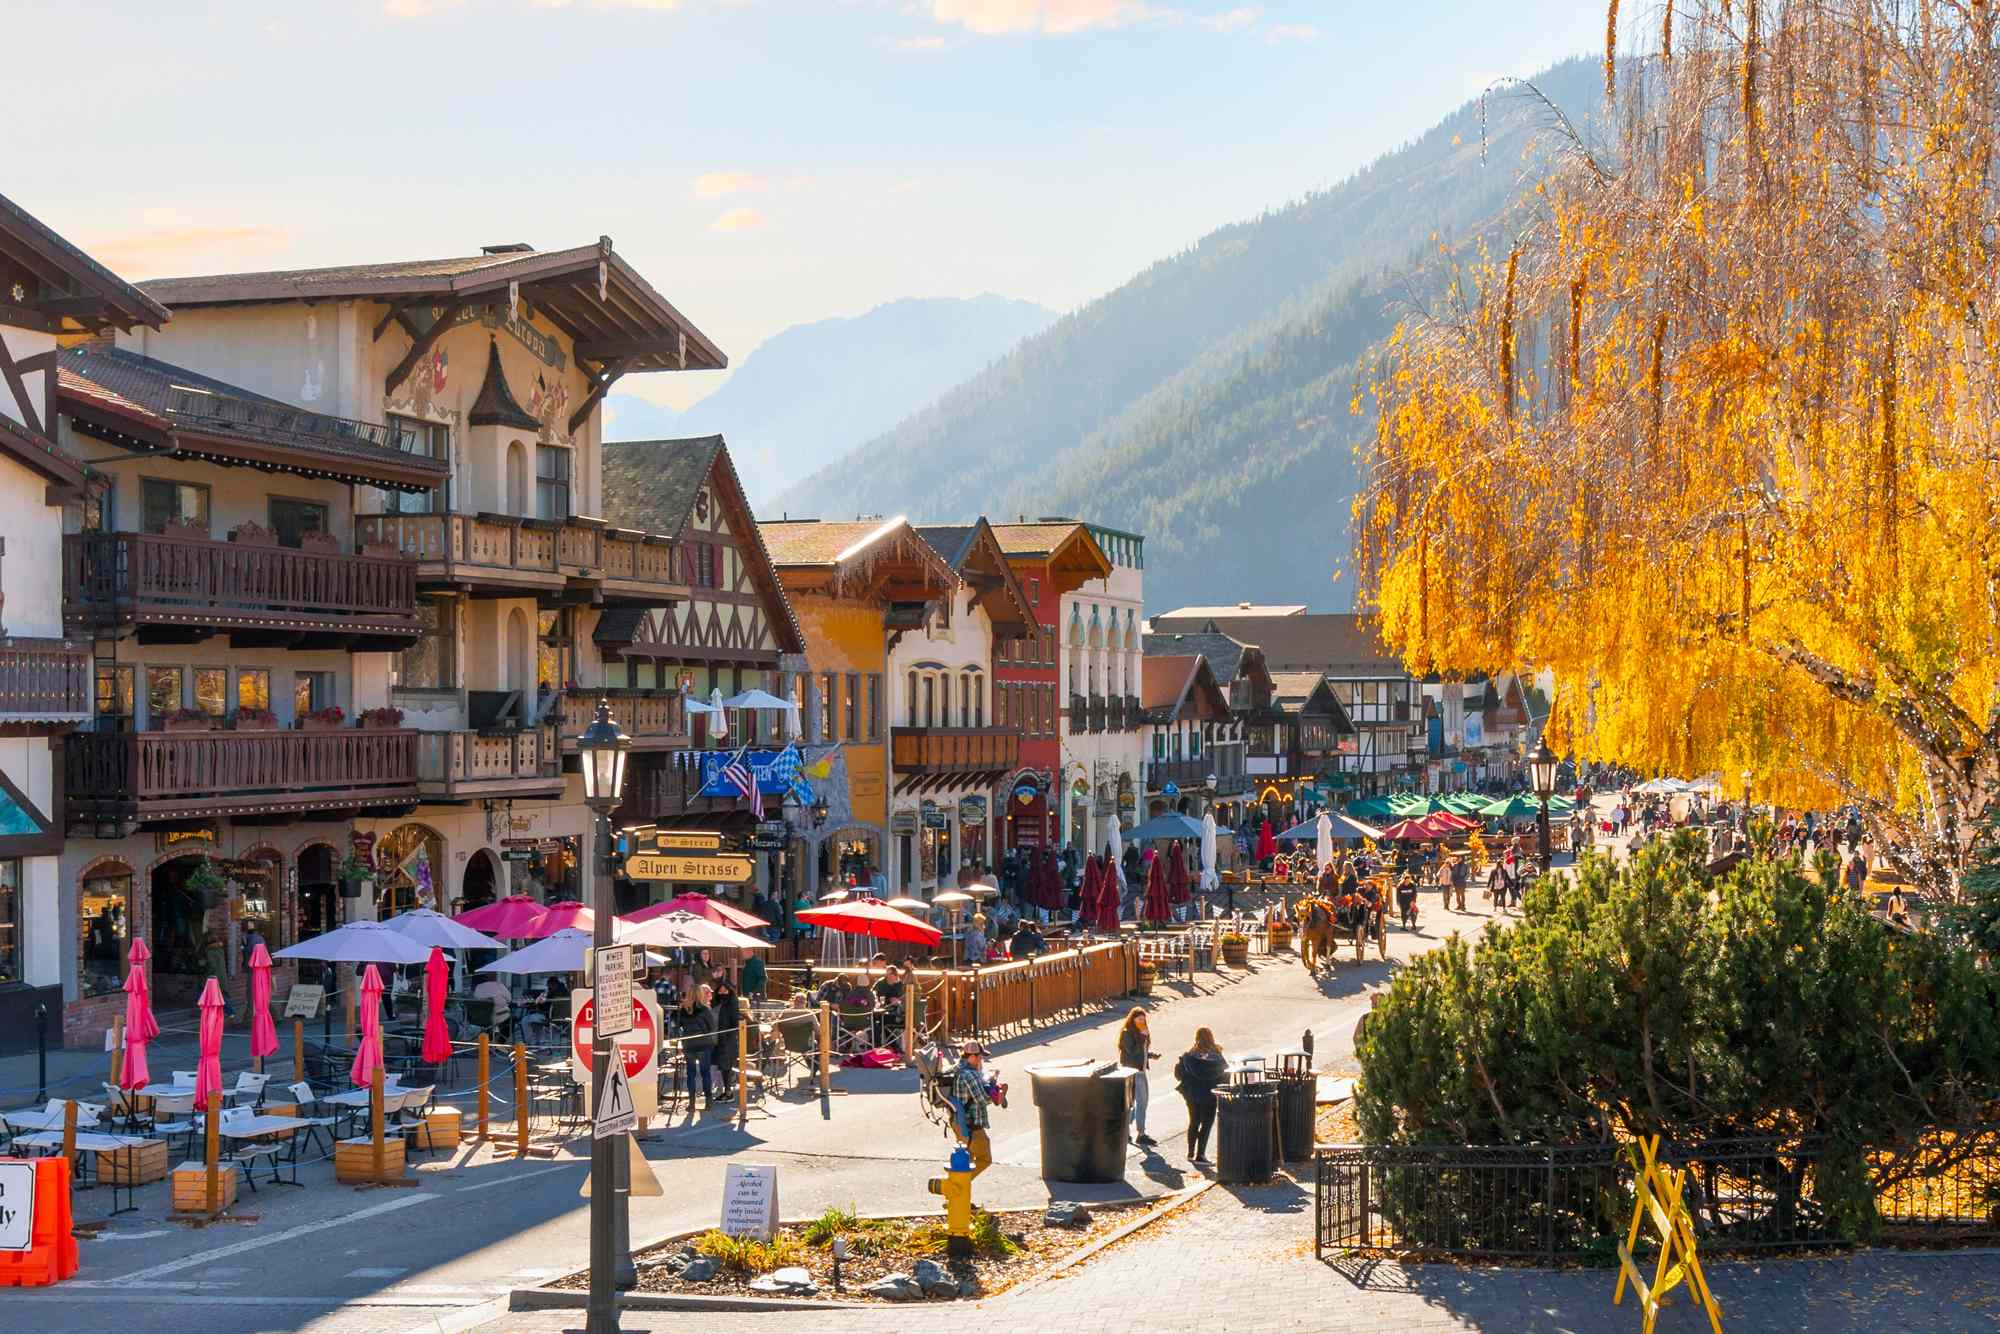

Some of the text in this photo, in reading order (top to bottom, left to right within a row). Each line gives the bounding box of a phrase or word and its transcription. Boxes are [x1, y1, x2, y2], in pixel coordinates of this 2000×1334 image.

[680, 838, 713, 847] Street
[639, 859, 740, 876] Alpen Strasse
[605, 961, 625, 971] PARKING
[736, 1179, 762, 1188] Alcohol
